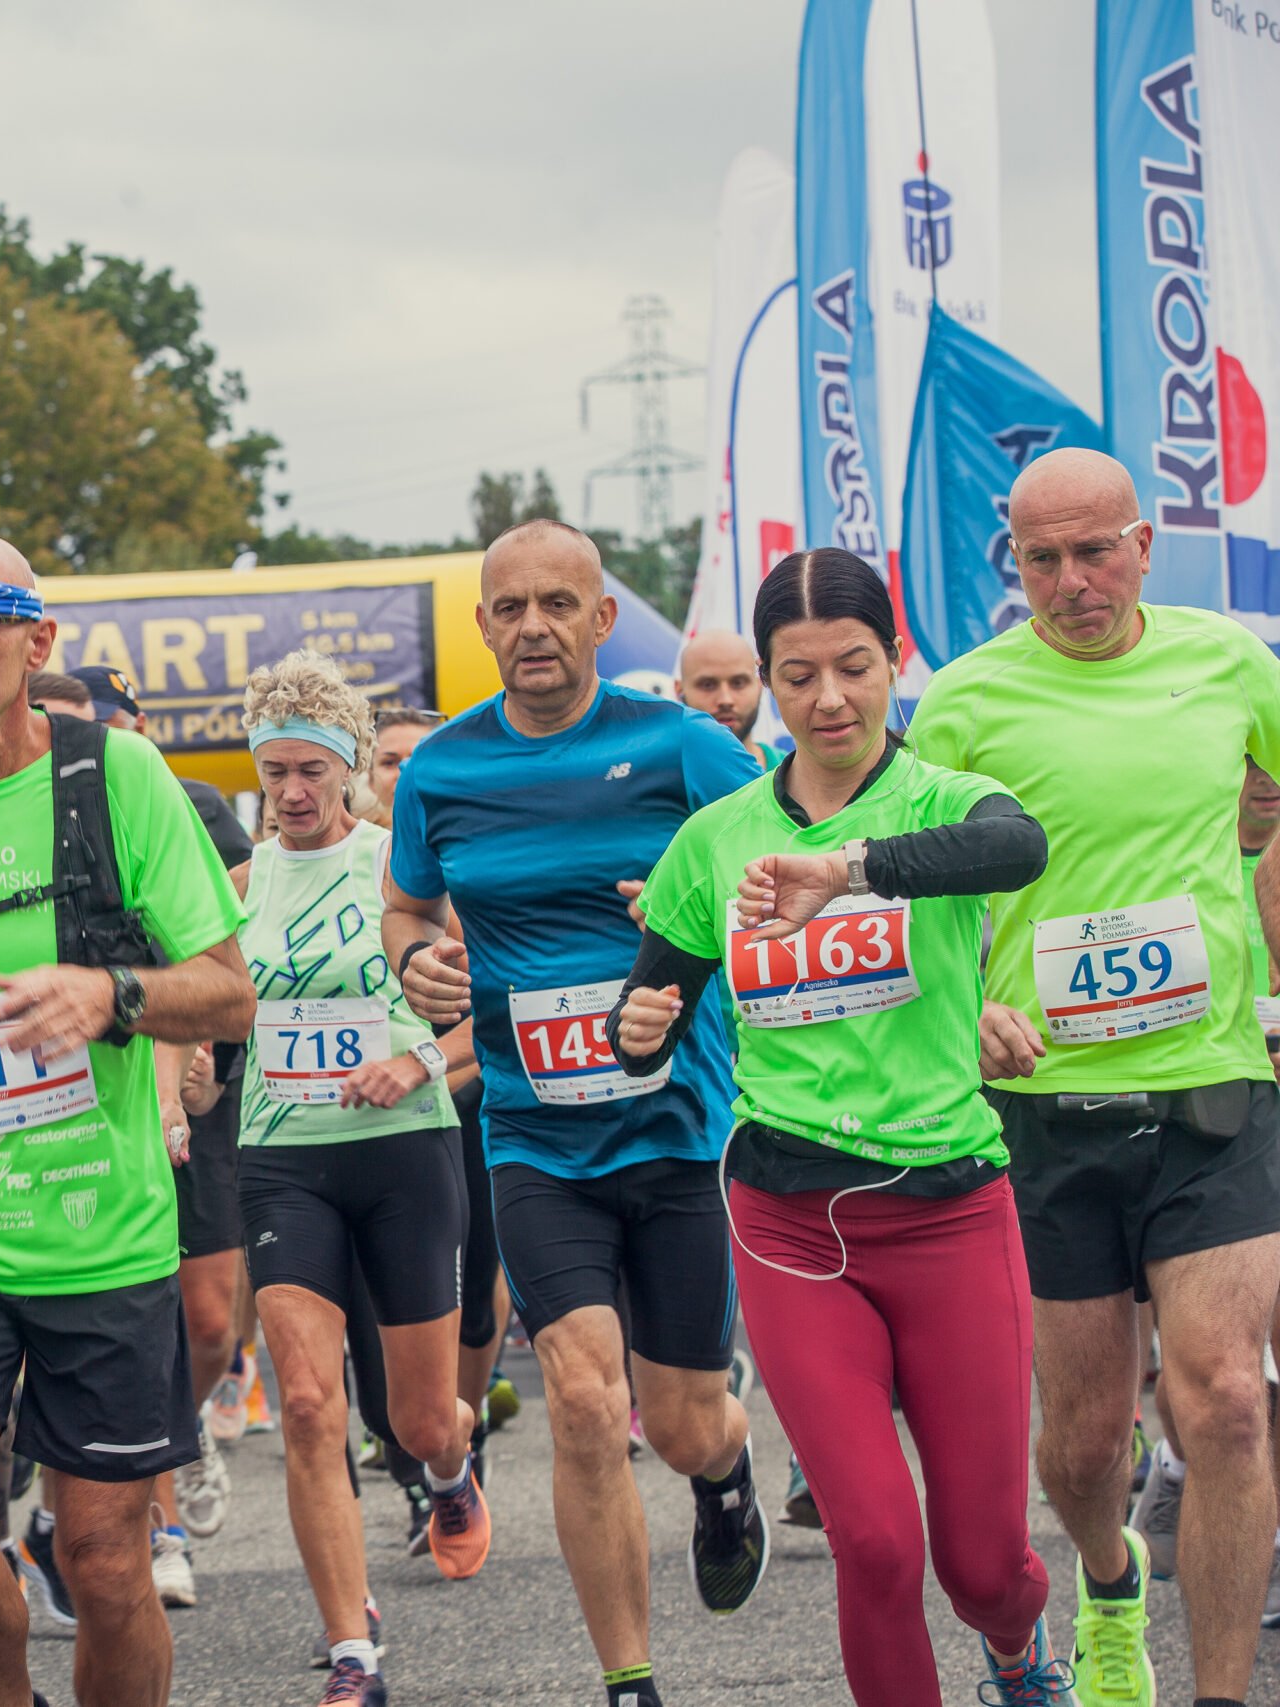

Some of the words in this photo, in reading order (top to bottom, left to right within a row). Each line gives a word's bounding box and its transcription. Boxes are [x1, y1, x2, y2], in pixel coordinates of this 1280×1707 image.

[1140, 54, 1222, 536] KROPLA
[50, 614, 265, 692] TART
[1099, 916, 1110, 924] 13.
[1111, 914, 1125, 922] PKO
[1101, 920, 1134, 932] BYTOMSKI
[744, 916, 893, 985] 1163
[803, 979, 838, 991] Agnieszka
[1069, 940, 1172, 1001] 459
[278, 1029, 363, 1070] 718
[528, 1018, 616, 1070] 145
[24, 1125, 97, 1146] castorama
[878, 1116, 940, 1133] castorama
[42, 1159, 111, 1184] DECATHLON
